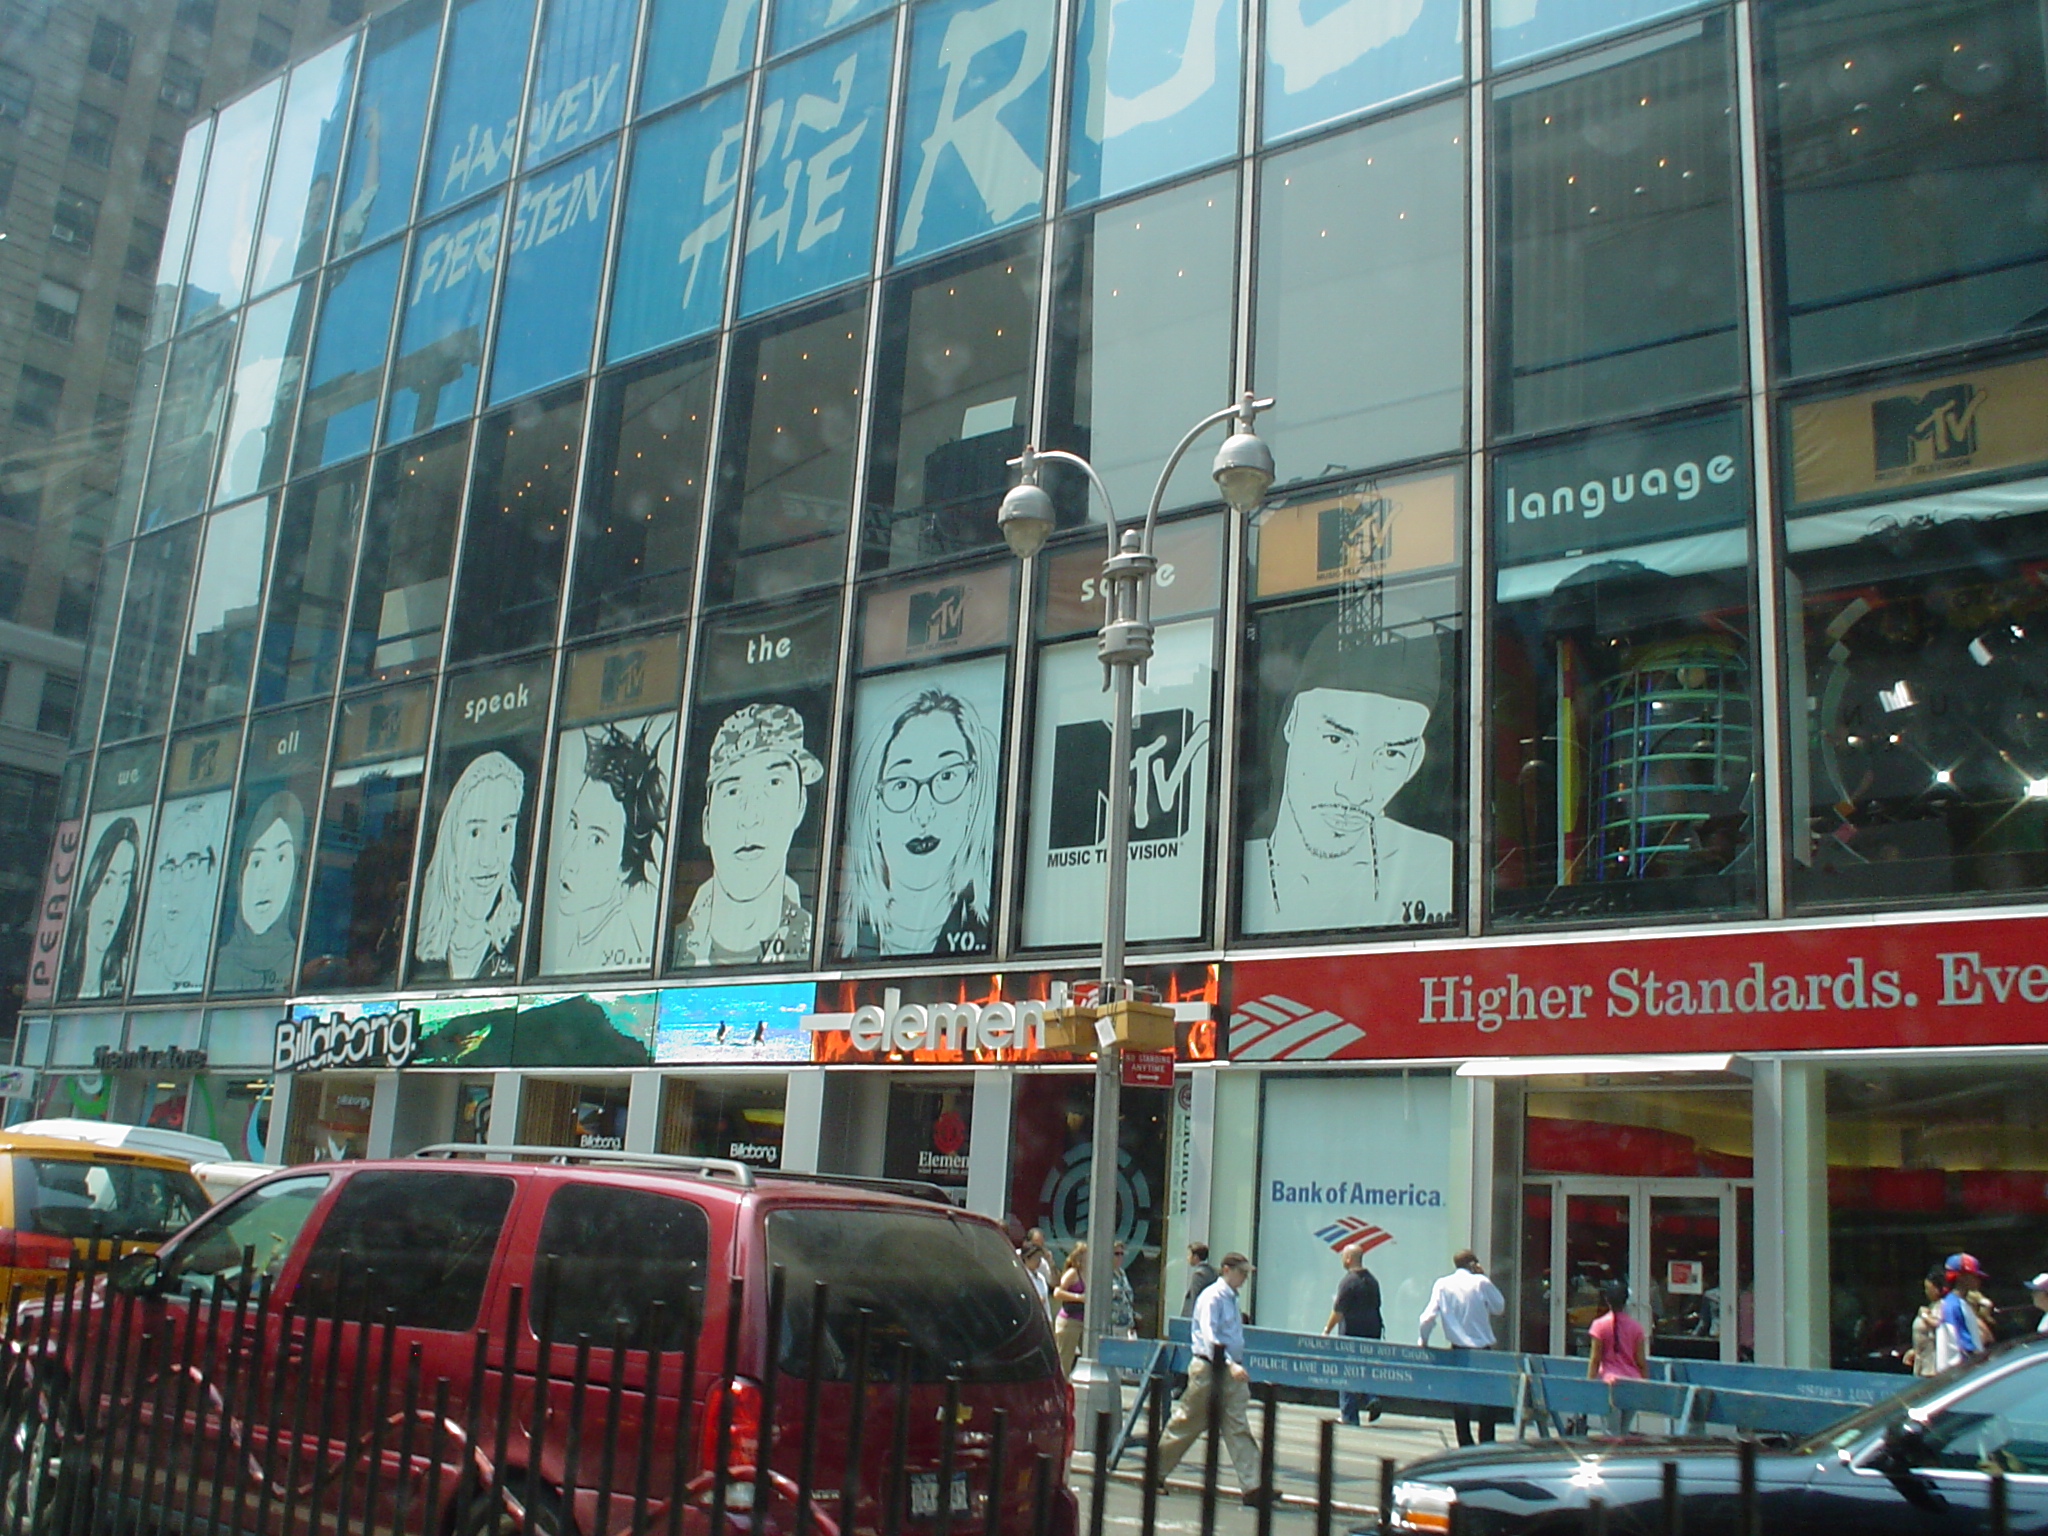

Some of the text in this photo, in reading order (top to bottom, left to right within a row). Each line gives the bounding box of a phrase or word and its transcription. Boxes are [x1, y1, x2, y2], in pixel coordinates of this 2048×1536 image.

[441, 62, 620, 202] HARVEY
[411, 160, 614, 307] FIERSTEIN
[679, 118, 868, 310] THE
[1872, 383, 1987, 471] MTV
[1507, 454, 1736, 524] language
[1317, 499, 1403, 573] MTV
[906, 585, 972, 647] MTV
[747, 633, 792, 664] the
[464, 683, 529, 723] speak
[277, 730, 300, 755] all
[118, 767, 139, 785] we
[1048, 707, 1210, 851] MTV
[1047, 842, 1179, 868] MUSIC TVISION
[32, 828, 79, 987] PEACE
[1418, 974, 1593, 1033] Higher
[1606, 957, 1919, 1018] Standards.
[919, 1151, 969, 1168] Elemen
[1271, 1180, 1322, 1203] Bank
[1326, 1182, 1348, 1204] of
[1250, 1355, 1414, 1382] POLICE LINE DO NOT CROSS
[1298, 1336, 1331, 1350] POLICE
[1334, 1339, 1356, 1353] LINE
[1360, 1343, 1374, 1354] DO
[1378, 1345, 1397, 1357] NOT
